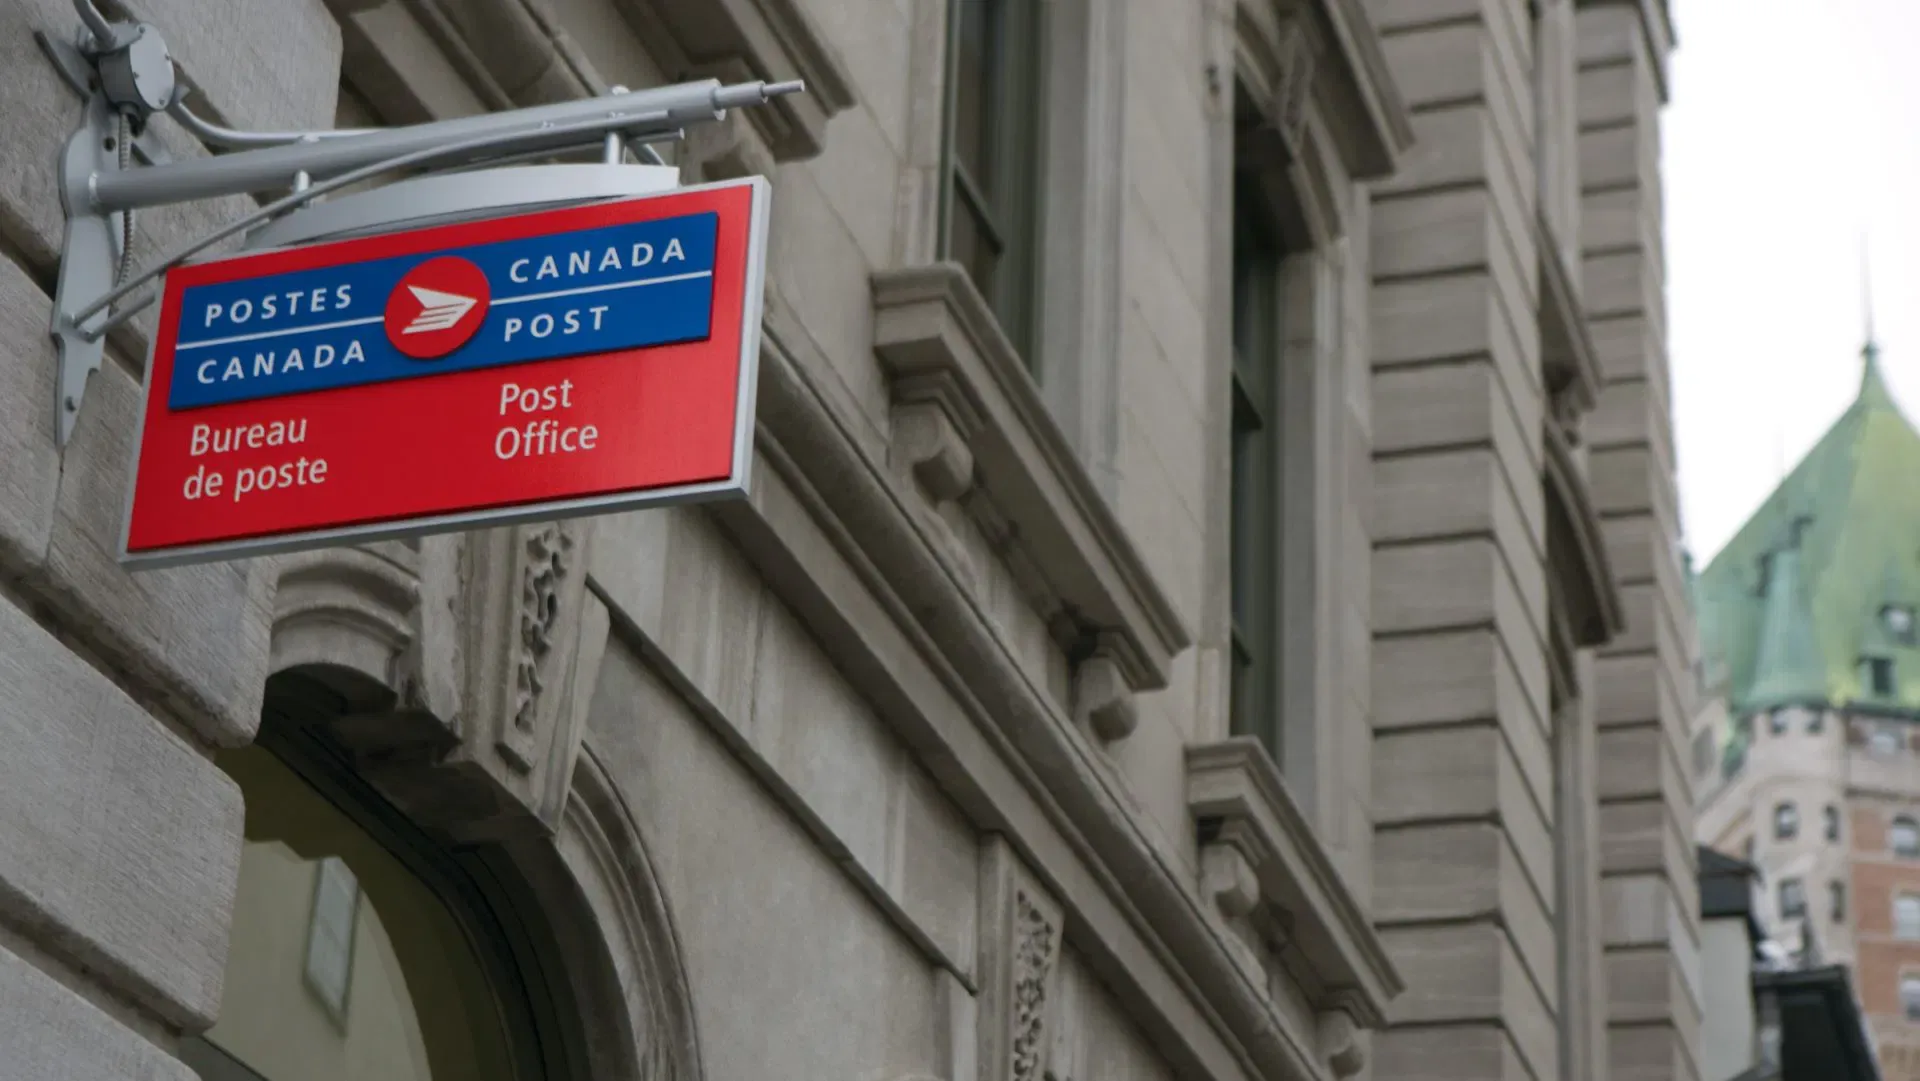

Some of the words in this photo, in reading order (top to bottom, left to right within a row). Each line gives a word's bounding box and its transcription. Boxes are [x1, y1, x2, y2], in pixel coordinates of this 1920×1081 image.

[509, 238, 686, 284] CANADA
[204, 285, 352, 327] POSTES
[503, 305, 609, 343] POST
[197, 340, 366, 385] CANADA
[498, 378, 574, 416] Post
[189, 418, 308, 457] Bureau
[494, 418, 599, 461] Office
[182, 464, 224, 500] de
[234, 456, 329, 503] poste
